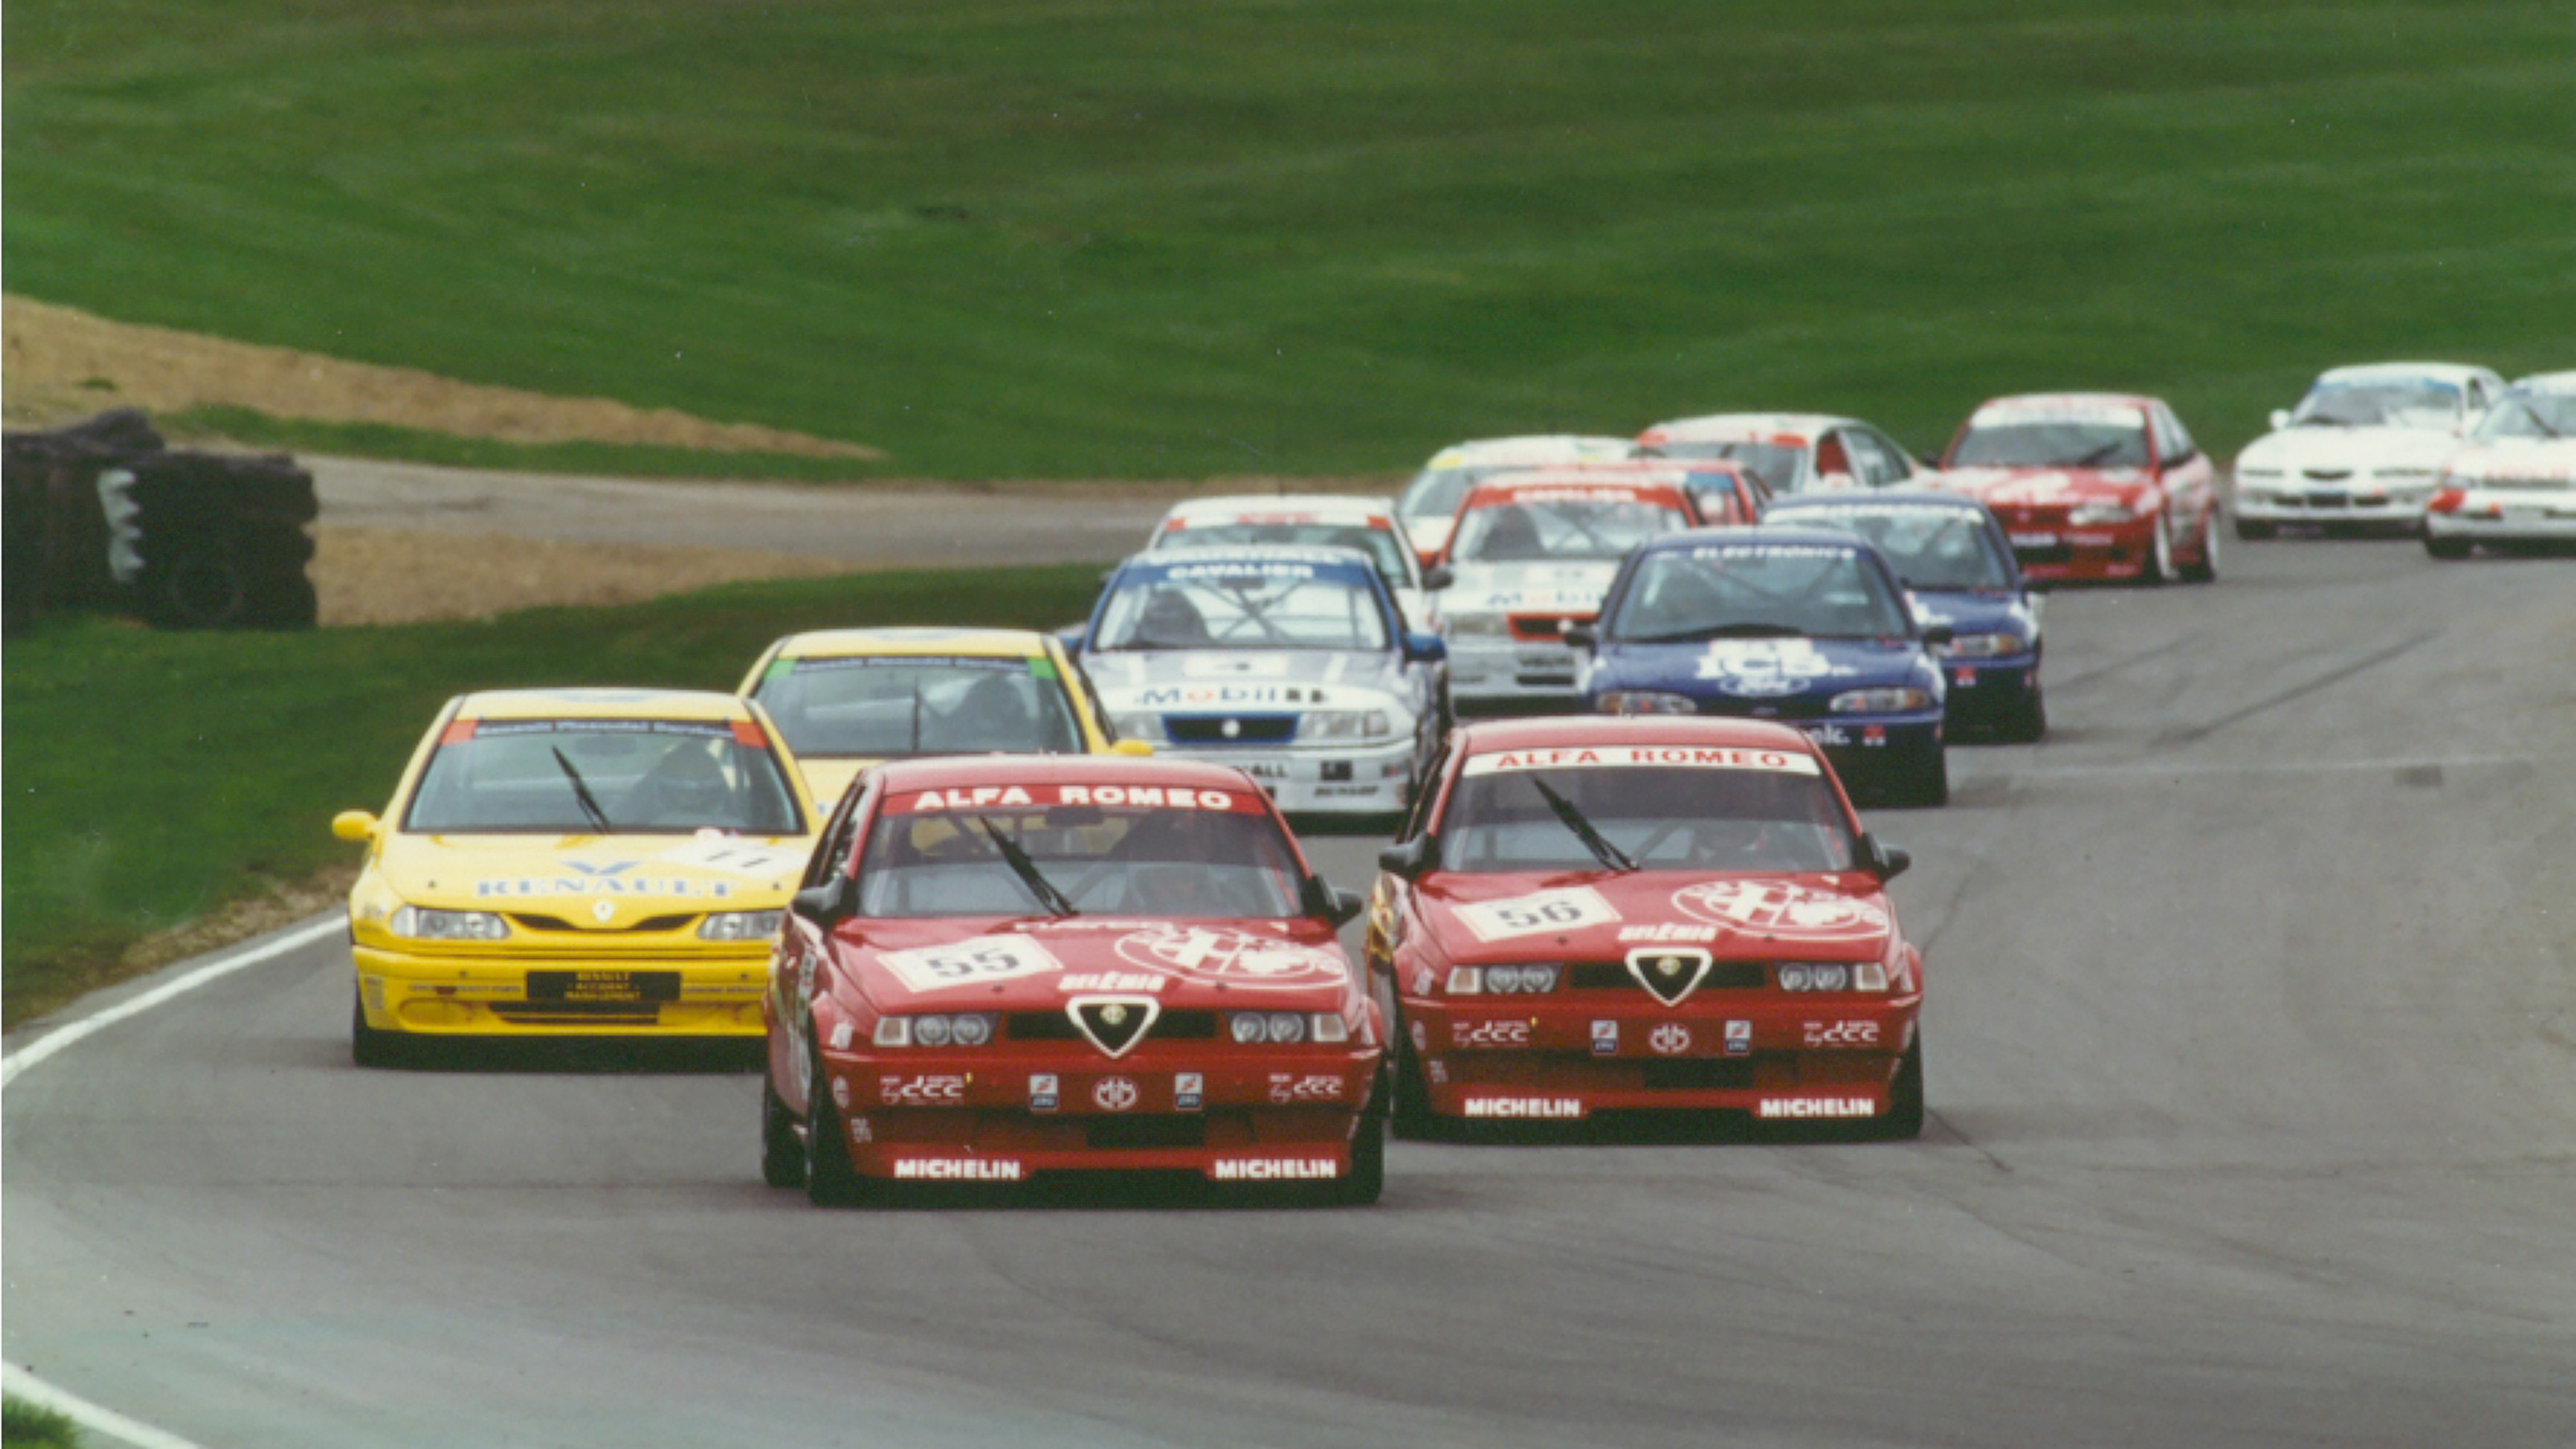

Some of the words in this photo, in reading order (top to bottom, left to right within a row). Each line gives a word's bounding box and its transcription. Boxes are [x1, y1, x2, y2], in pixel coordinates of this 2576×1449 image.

[1169, 564, 1314, 580] CAVALIER
[1143, 686, 1276, 705] Mobil
[1496, 749, 1600, 767] ALFA
[1630, 749, 1788, 767] ROMEO
[914, 786, 1032, 810] ALFA
[1059, 785, 1232, 810] ROMEO
[477, 877, 731, 897] RENAULT
[1497, 901, 1582, 928] 56
[927, 948, 1020, 978] 55
[1464, 1097, 1580, 1117] MICHELIN
[1760, 1098, 1875, 1117] MICHELIN
[894, 1159, 1021, 1179] MICHELIN
[1216, 1159, 1336, 1179] MICHELIN
